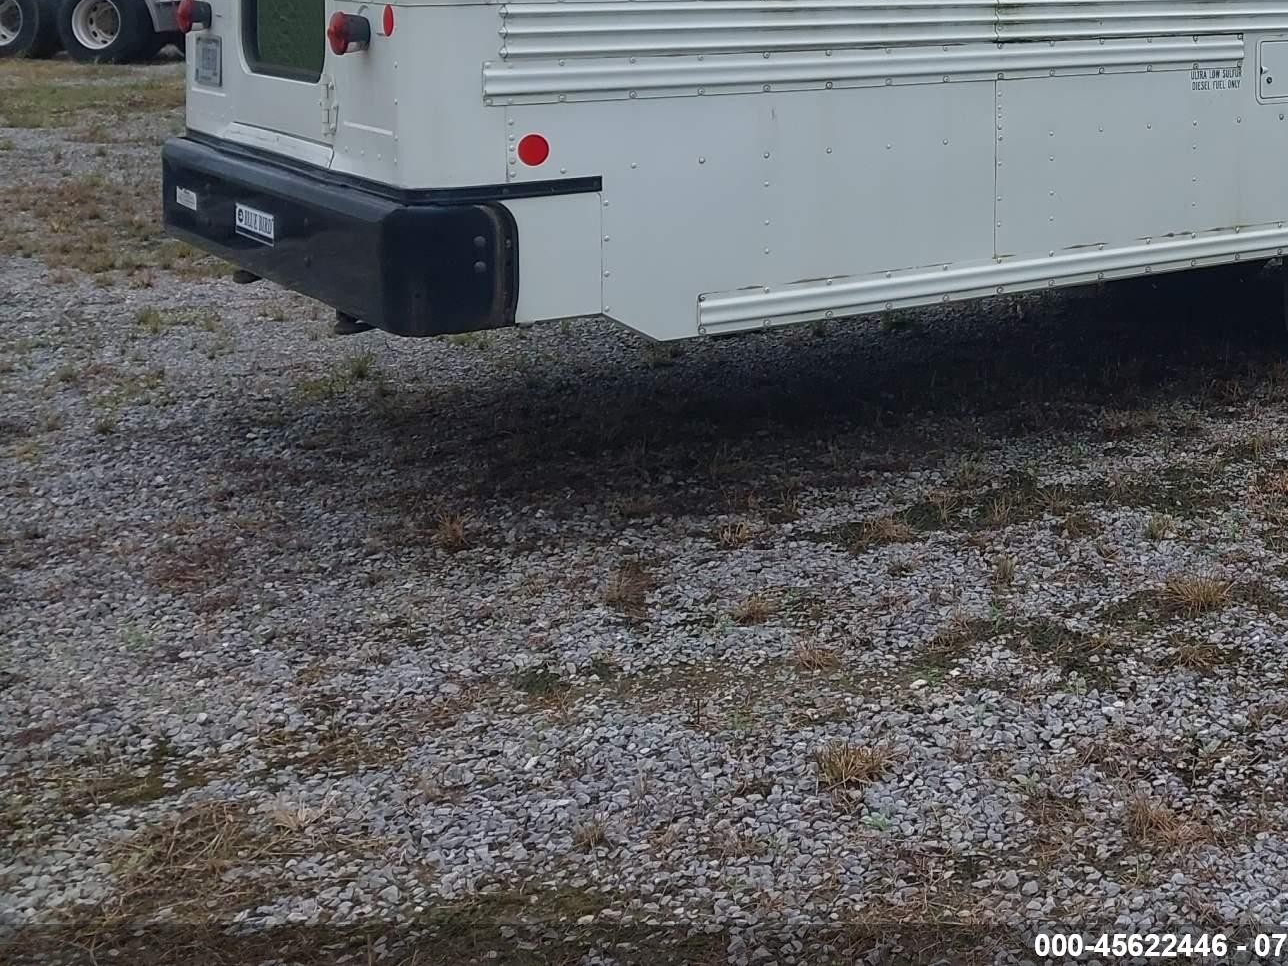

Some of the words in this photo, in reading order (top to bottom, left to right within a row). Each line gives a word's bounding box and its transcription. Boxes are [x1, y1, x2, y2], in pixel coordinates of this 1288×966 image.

[1209, 69, 1220, 79] LOW
[1192, 81, 1210, 91] DIESEL
[1213, 80, 1226, 90] FUEL
[1227, 79, 1240, 89] ONLY
